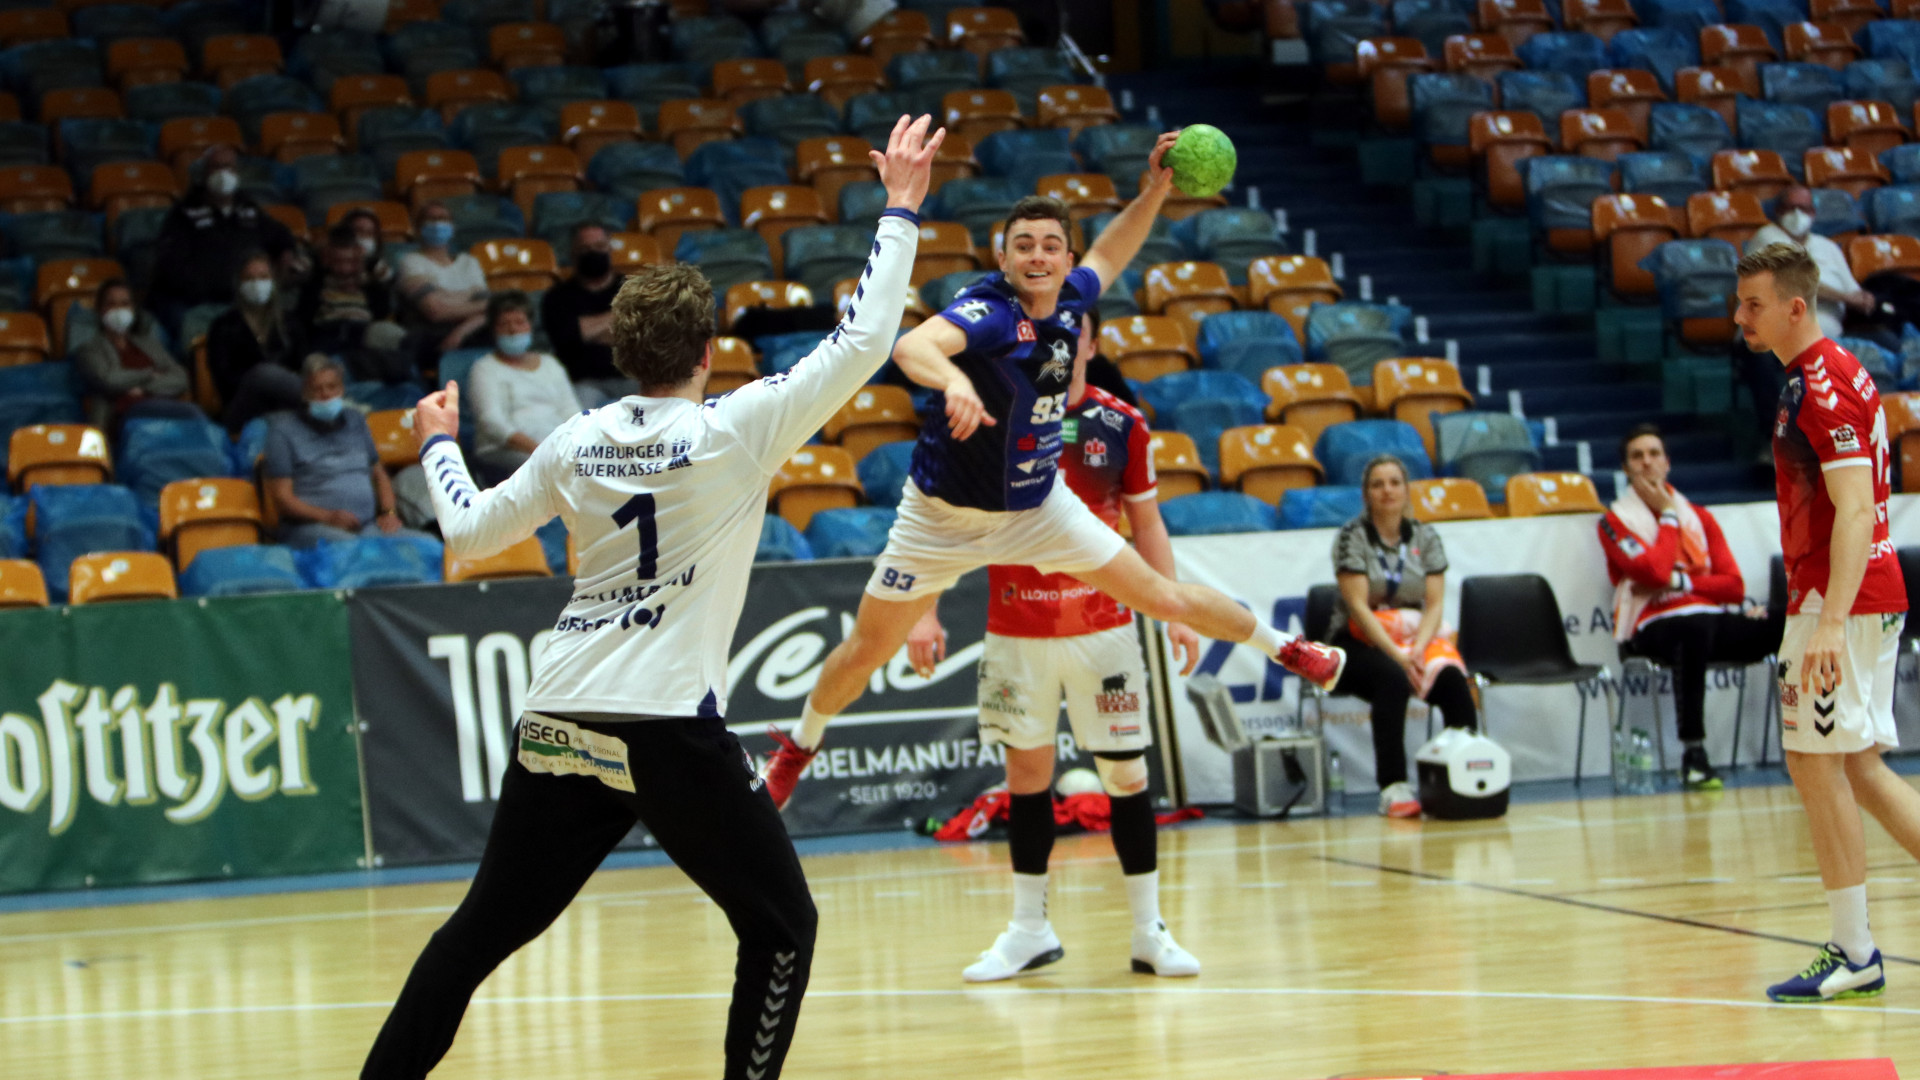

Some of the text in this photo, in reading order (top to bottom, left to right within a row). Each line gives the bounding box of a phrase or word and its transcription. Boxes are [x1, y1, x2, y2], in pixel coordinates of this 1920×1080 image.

[1030, 392, 1066, 425] 93
[574, 461, 662, 478] FEUERKASSE
[611, 493, 659, 580] 1
[881, 567, 916, 592] 93
[1020, 588, 1060, 602] LLOYD
[427, 630, 560, 803] 10
[520, 718, 575, 752] HSEQ
